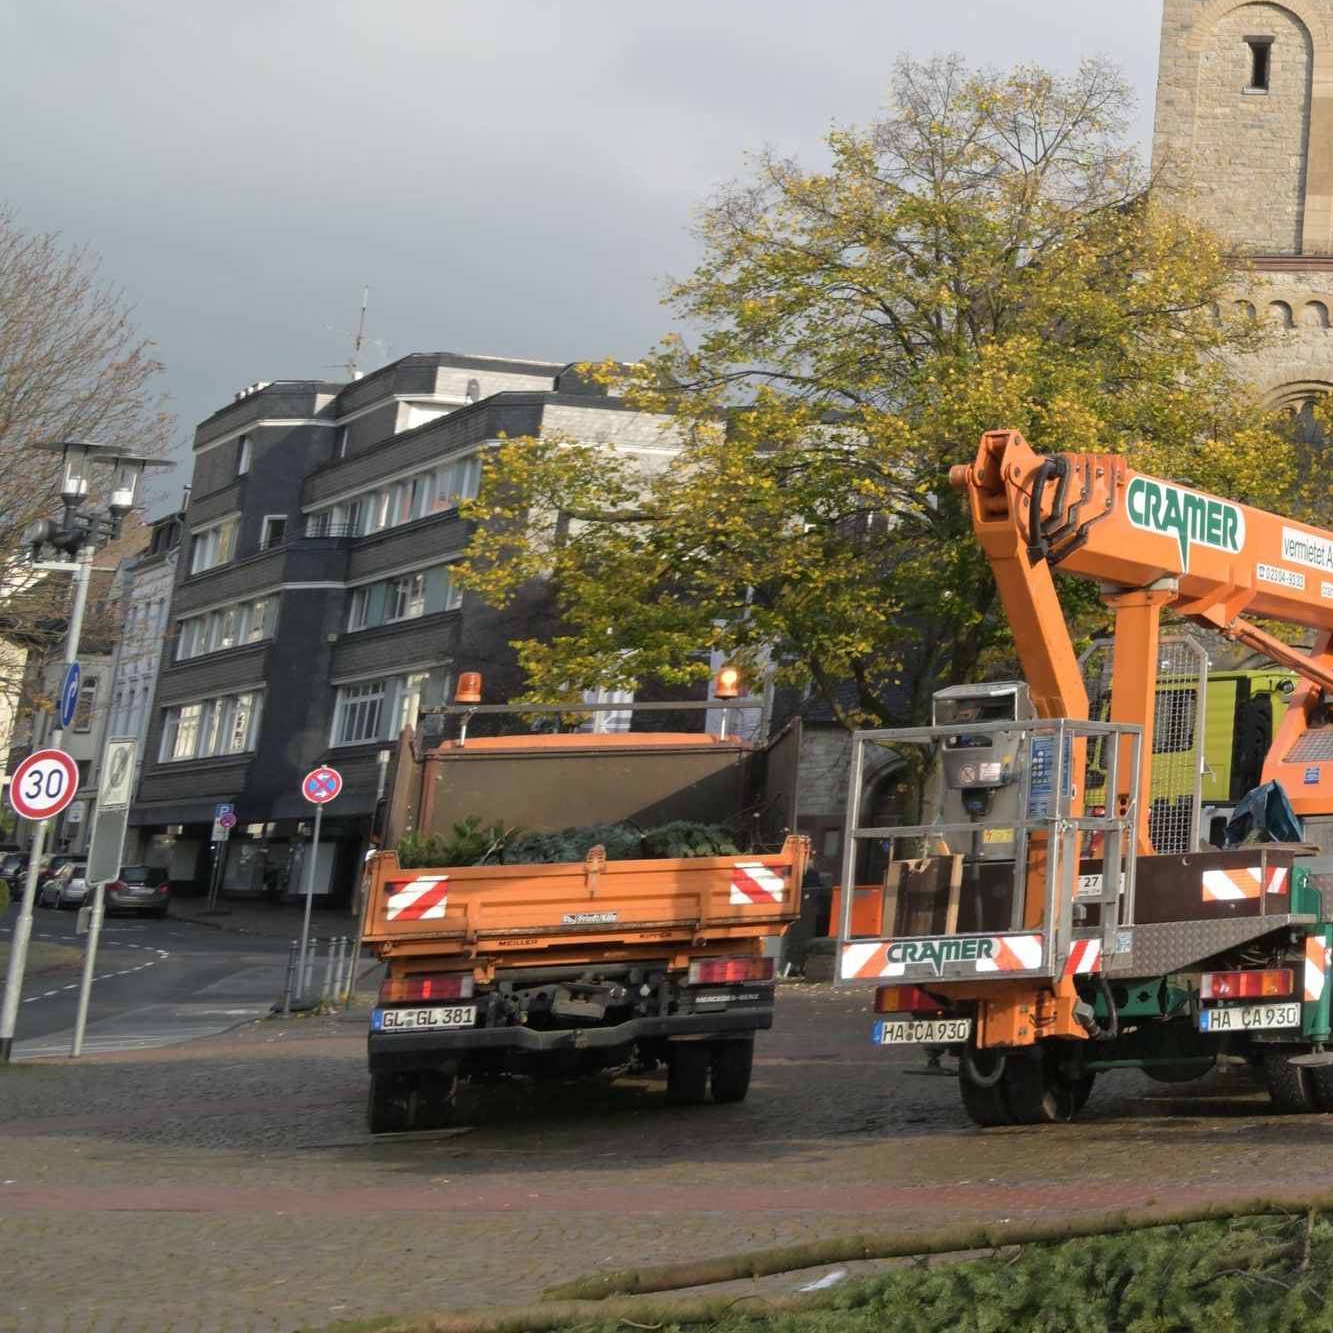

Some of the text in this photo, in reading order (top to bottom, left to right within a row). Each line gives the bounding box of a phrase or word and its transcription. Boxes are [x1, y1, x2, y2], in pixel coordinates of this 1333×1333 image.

[1128, 478, 1239, 572] CRAMER
[1284, 538, 1325, 566] vermietet
[24, 769, 63, 800] 30
[1084, 877, 1099, 888] 27
[498, 939, 538, 947] MEILLER
[887, 938, 993, 976] CRAMER
[695, 994, 759, 1004] MERCEDES-BENZ
[383, 1008, 474, 1028] GL GL 381
[1211, 1006, 1297, 1029] HA CA 930
[883, 1022, 967, 1042] HA CA 930
